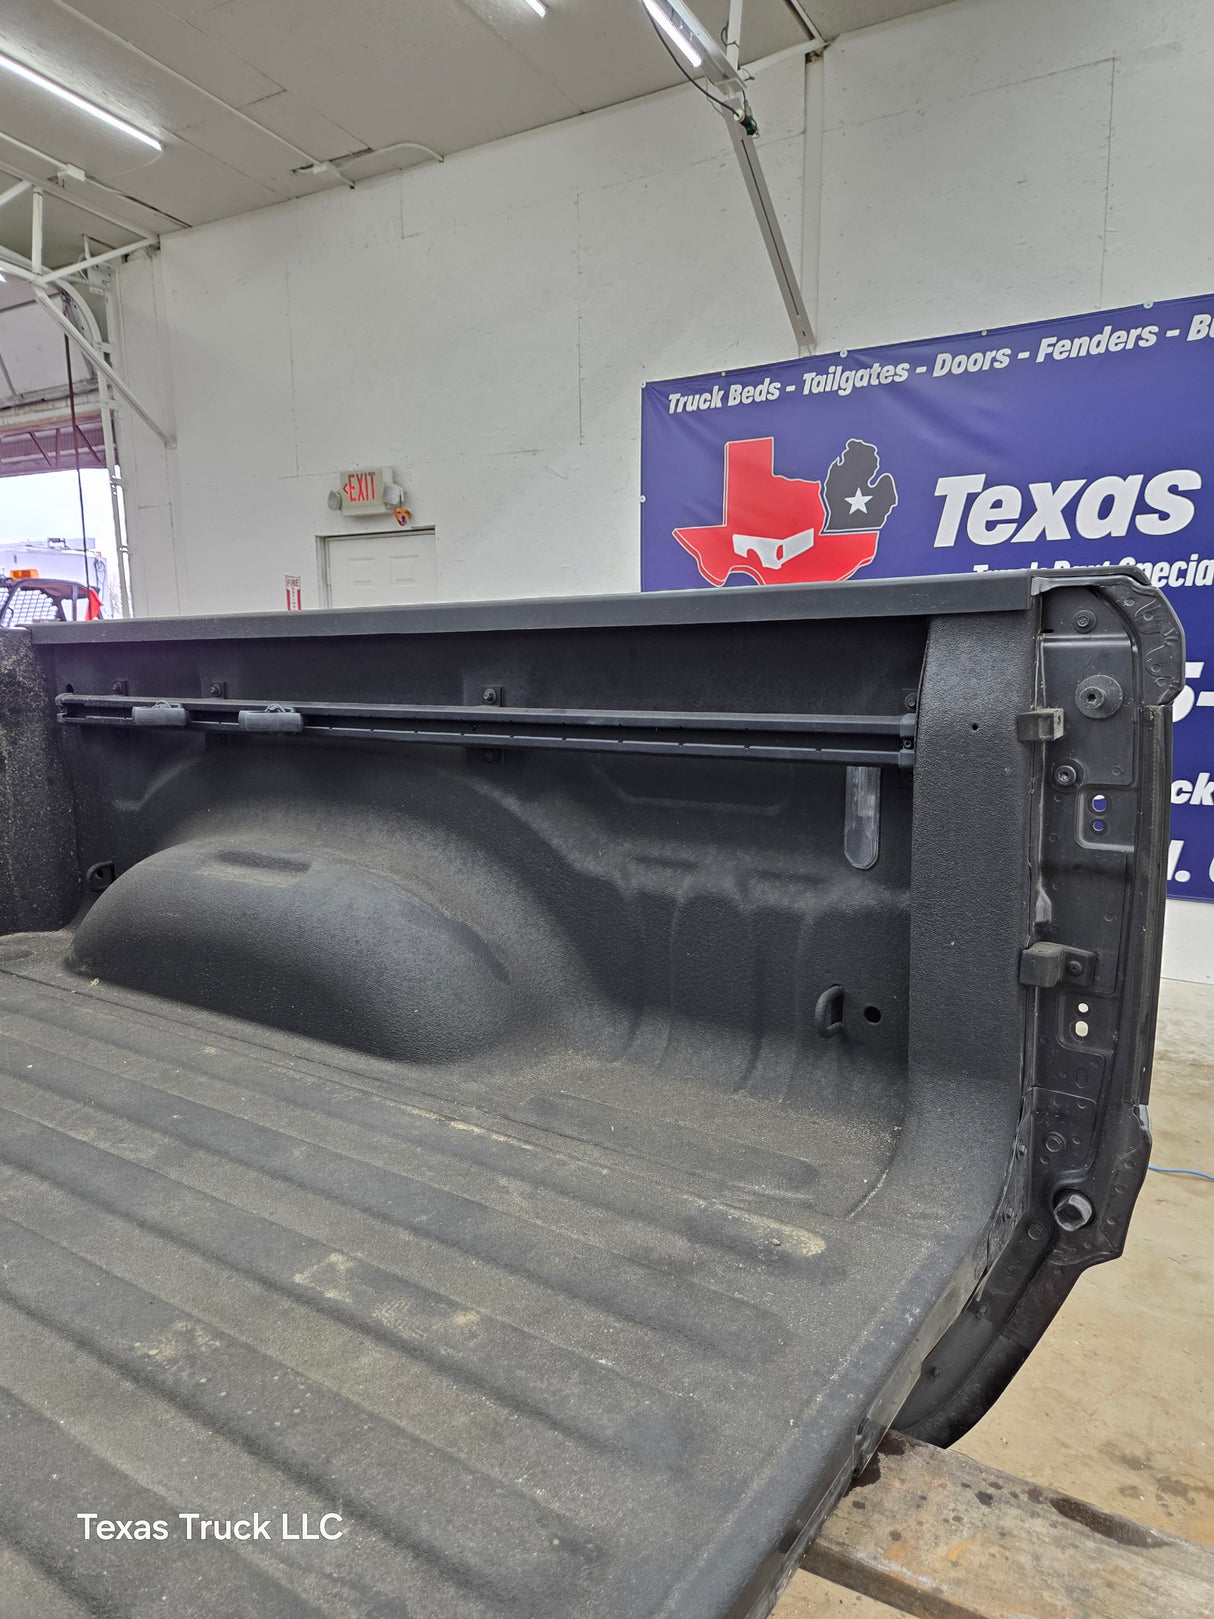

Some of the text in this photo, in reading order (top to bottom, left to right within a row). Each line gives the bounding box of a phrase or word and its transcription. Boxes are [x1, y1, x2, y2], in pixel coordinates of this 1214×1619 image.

[668, 385, 725, 415] Truck
[727, 377, 781, 407] Beds
[802, 363, 910, 396] Tailgates
[932, 348, 1012, 378] Doors
[1036, 325, 1159, 363] Fenders
[347, 472, 376, 502] EXIT
[933, 469, 1203, 548] Texas
[1171, 772, 1214, 806] ck
